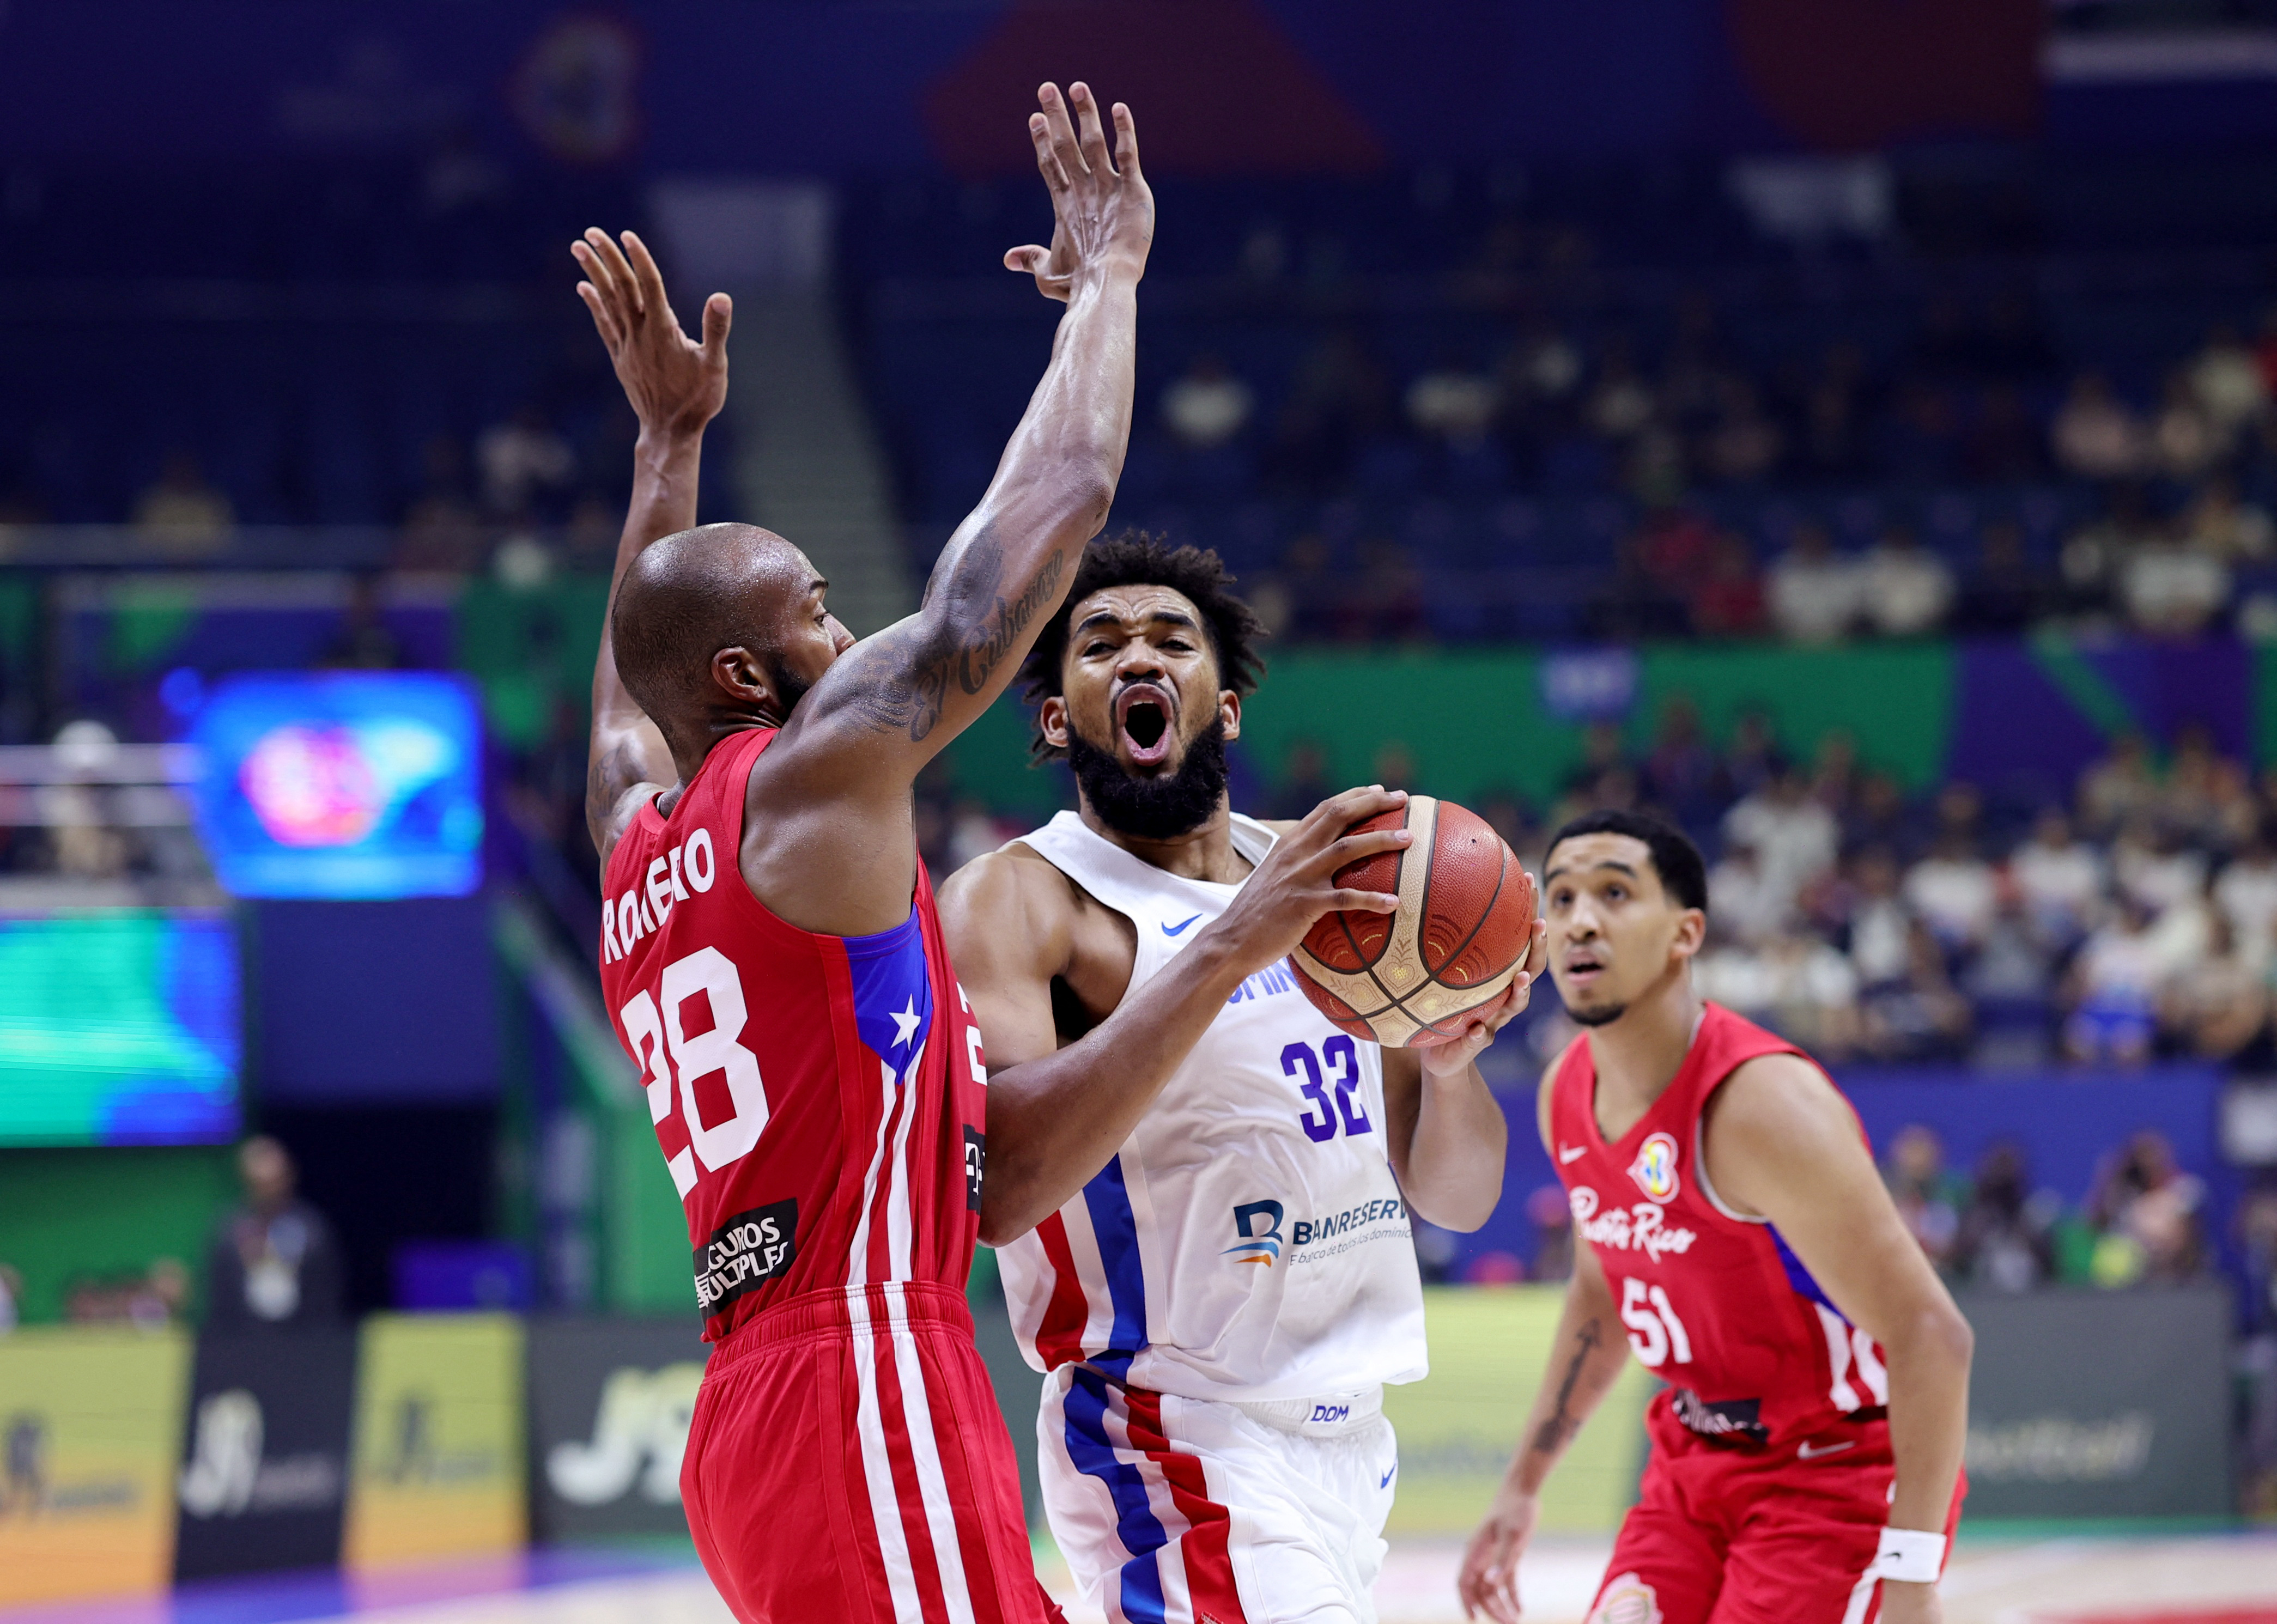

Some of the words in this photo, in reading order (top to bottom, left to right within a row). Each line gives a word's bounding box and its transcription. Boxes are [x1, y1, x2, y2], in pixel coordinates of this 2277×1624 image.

[620, 946, 769, 1202] 28
[1280, 1035, 1373, 1142] 32
[1632, 1202, 1697, 1264] Rico
[1621, 1276, 1693, 1367] 51
[1310, 1405, 1349, 1421] DOM
